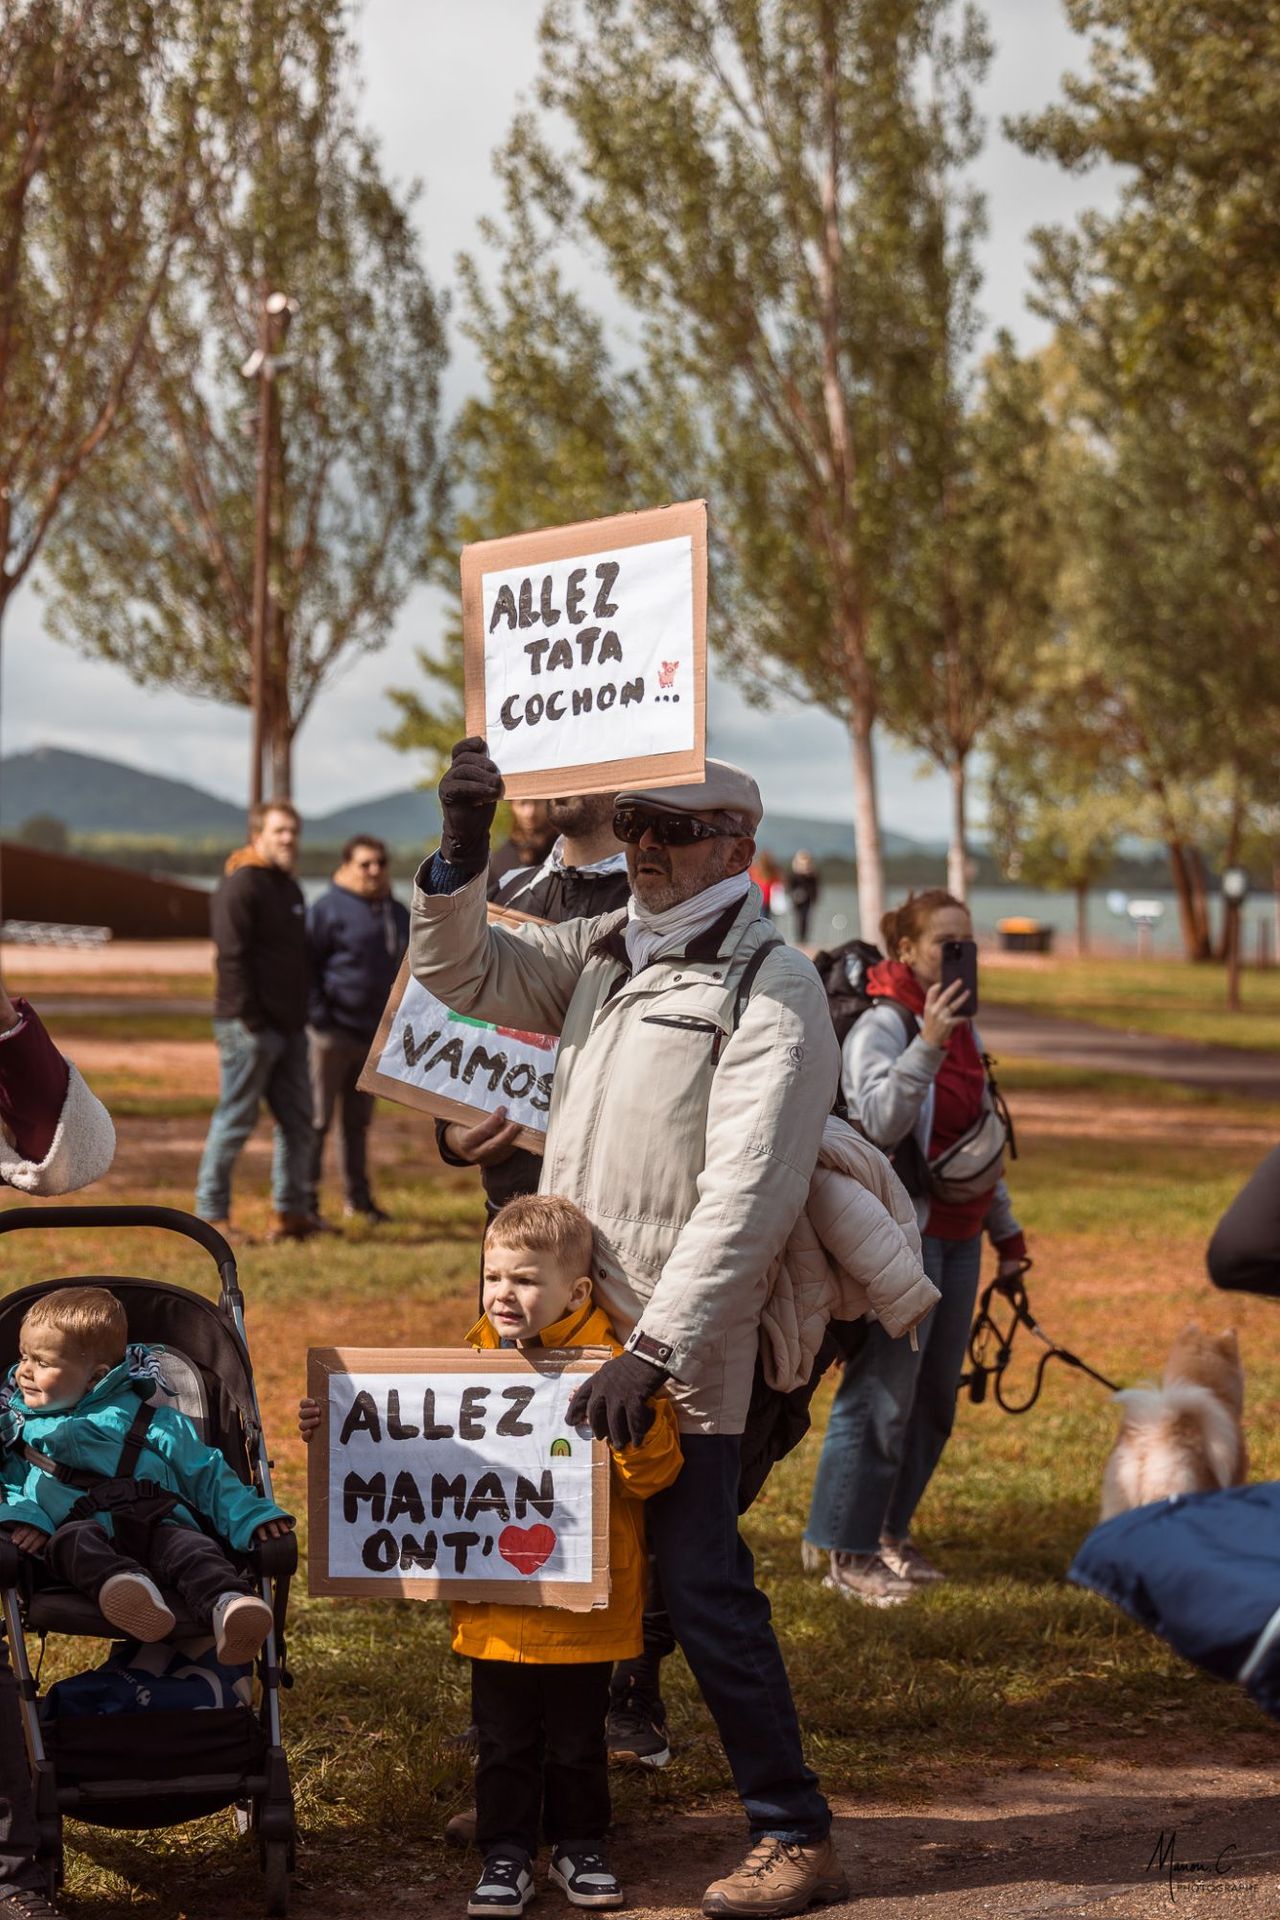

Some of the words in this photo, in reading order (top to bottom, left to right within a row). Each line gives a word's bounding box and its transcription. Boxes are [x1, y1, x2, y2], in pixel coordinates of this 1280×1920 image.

[489, 561, 620, 634] ALLEZ
[524, 627, 623, 675] TATA
[403, 1023, 555, 1112] VAMOS
[340, 1385, 536, 1445] ALLEZ
[343, 1470, 555, 1524] MAMAN
